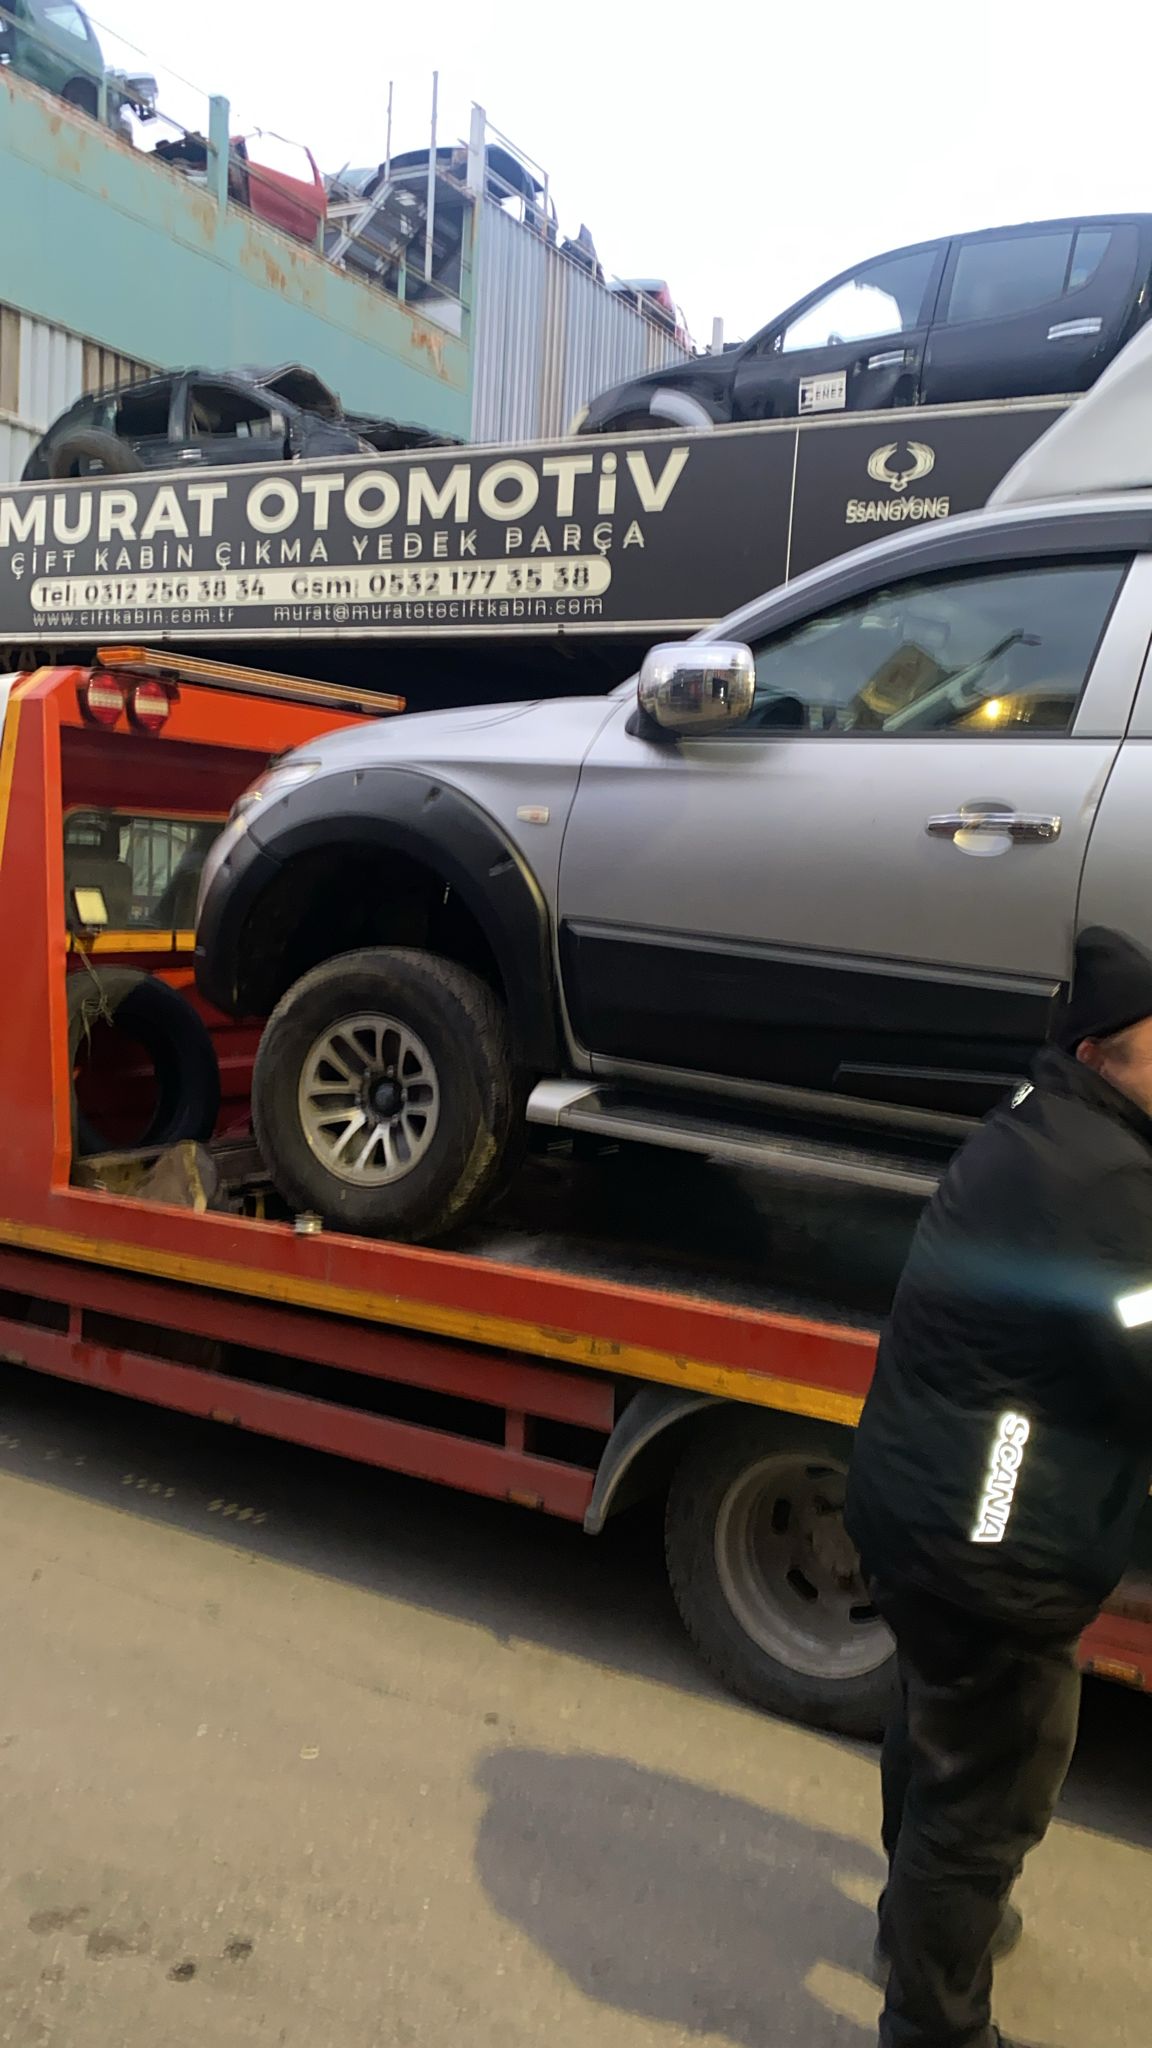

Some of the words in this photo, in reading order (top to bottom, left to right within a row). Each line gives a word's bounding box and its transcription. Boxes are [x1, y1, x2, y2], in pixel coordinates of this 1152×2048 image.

[0, 482, 228, 547] MURAT
[11, 548, 76, 579] ÇİFT
[95, 541, 194, 572] KABİN
[215, 537, 328, 571] ÇIKMA
[352, 529, 477, 561] YEDEK
[506, 520, 645, 556] PARÇA
[85, 580, 137, 605] 0312
[236, 574, 265, 602] 34
[369, 567, 439, 597] 0532
[450, 565, 496, 595] 177
[507, 563, 542, 593] 35
[971, 1411, 1029, 1541] SCANIA
